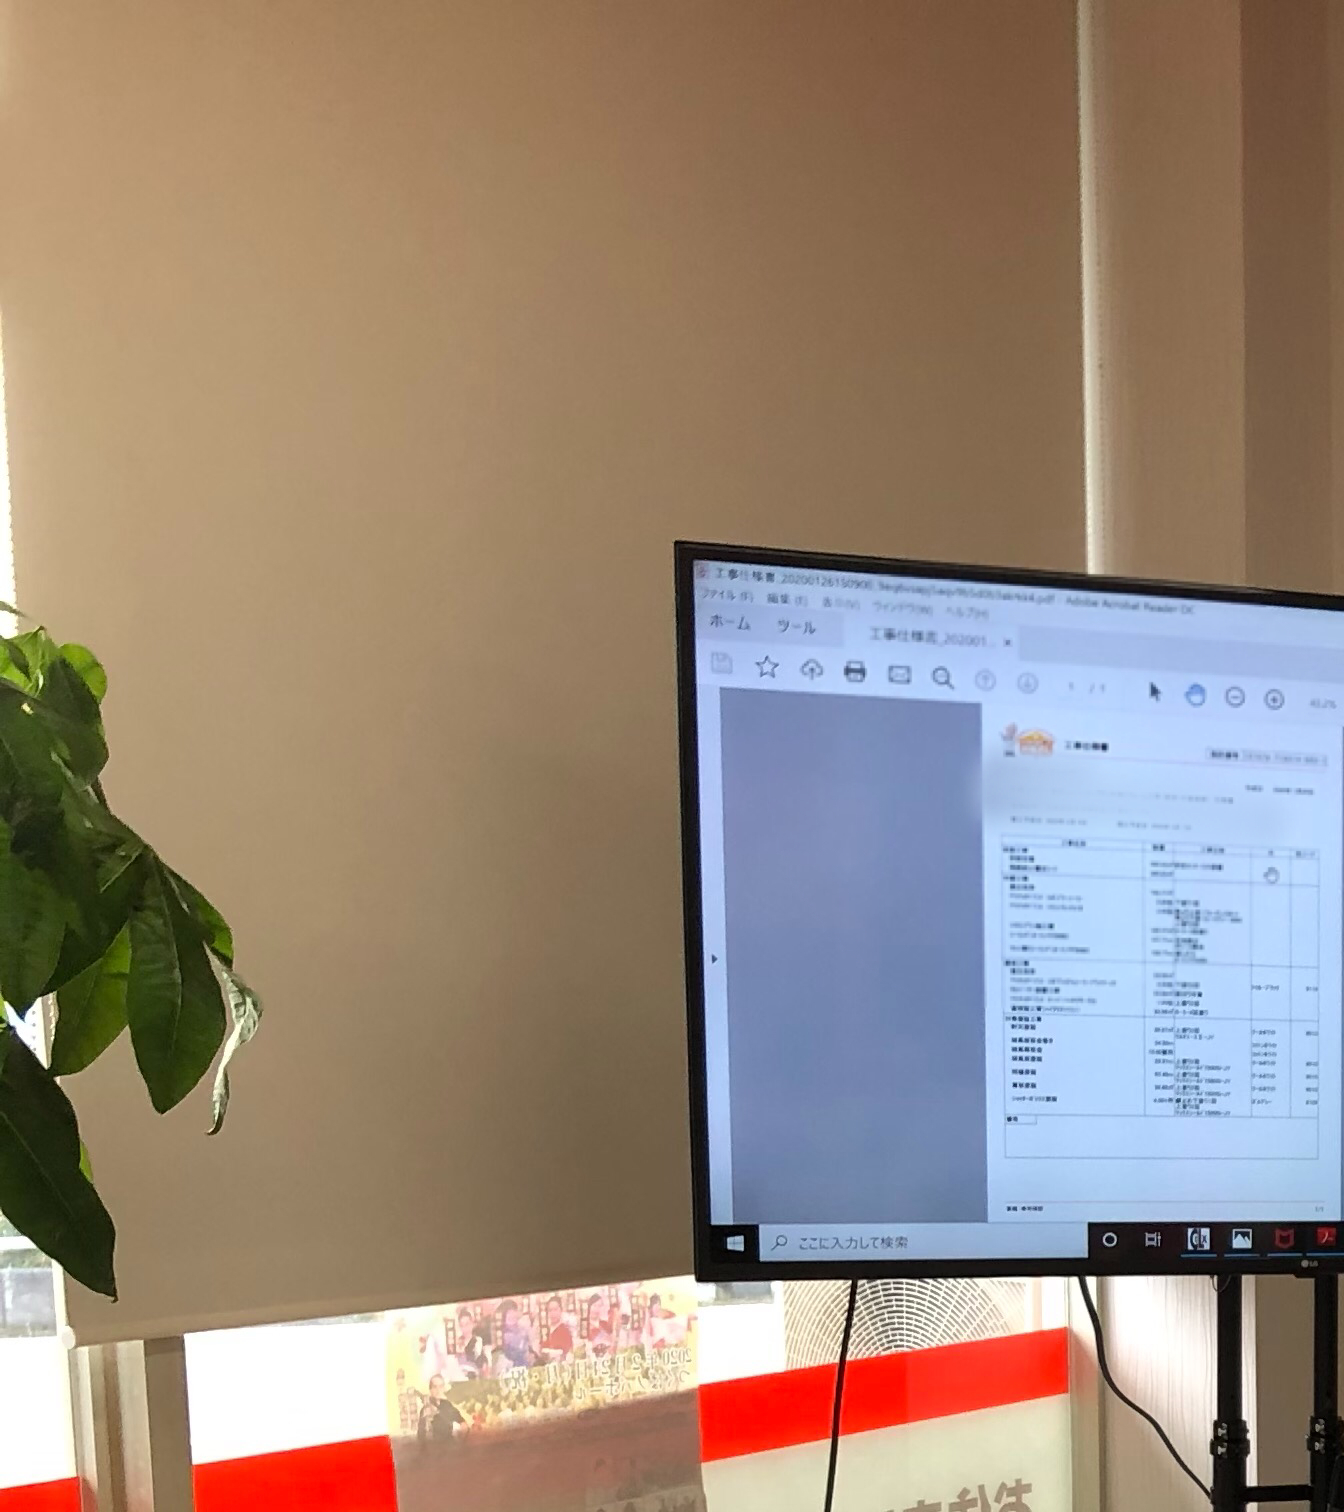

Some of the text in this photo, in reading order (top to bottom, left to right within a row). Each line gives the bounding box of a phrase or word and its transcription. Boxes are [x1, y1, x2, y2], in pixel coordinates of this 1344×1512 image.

[710, 614, 751, 631] ホーム
[777, 618, 817, 635] ツール
[798, 1235, 908, 1251] ここに入力して検索
